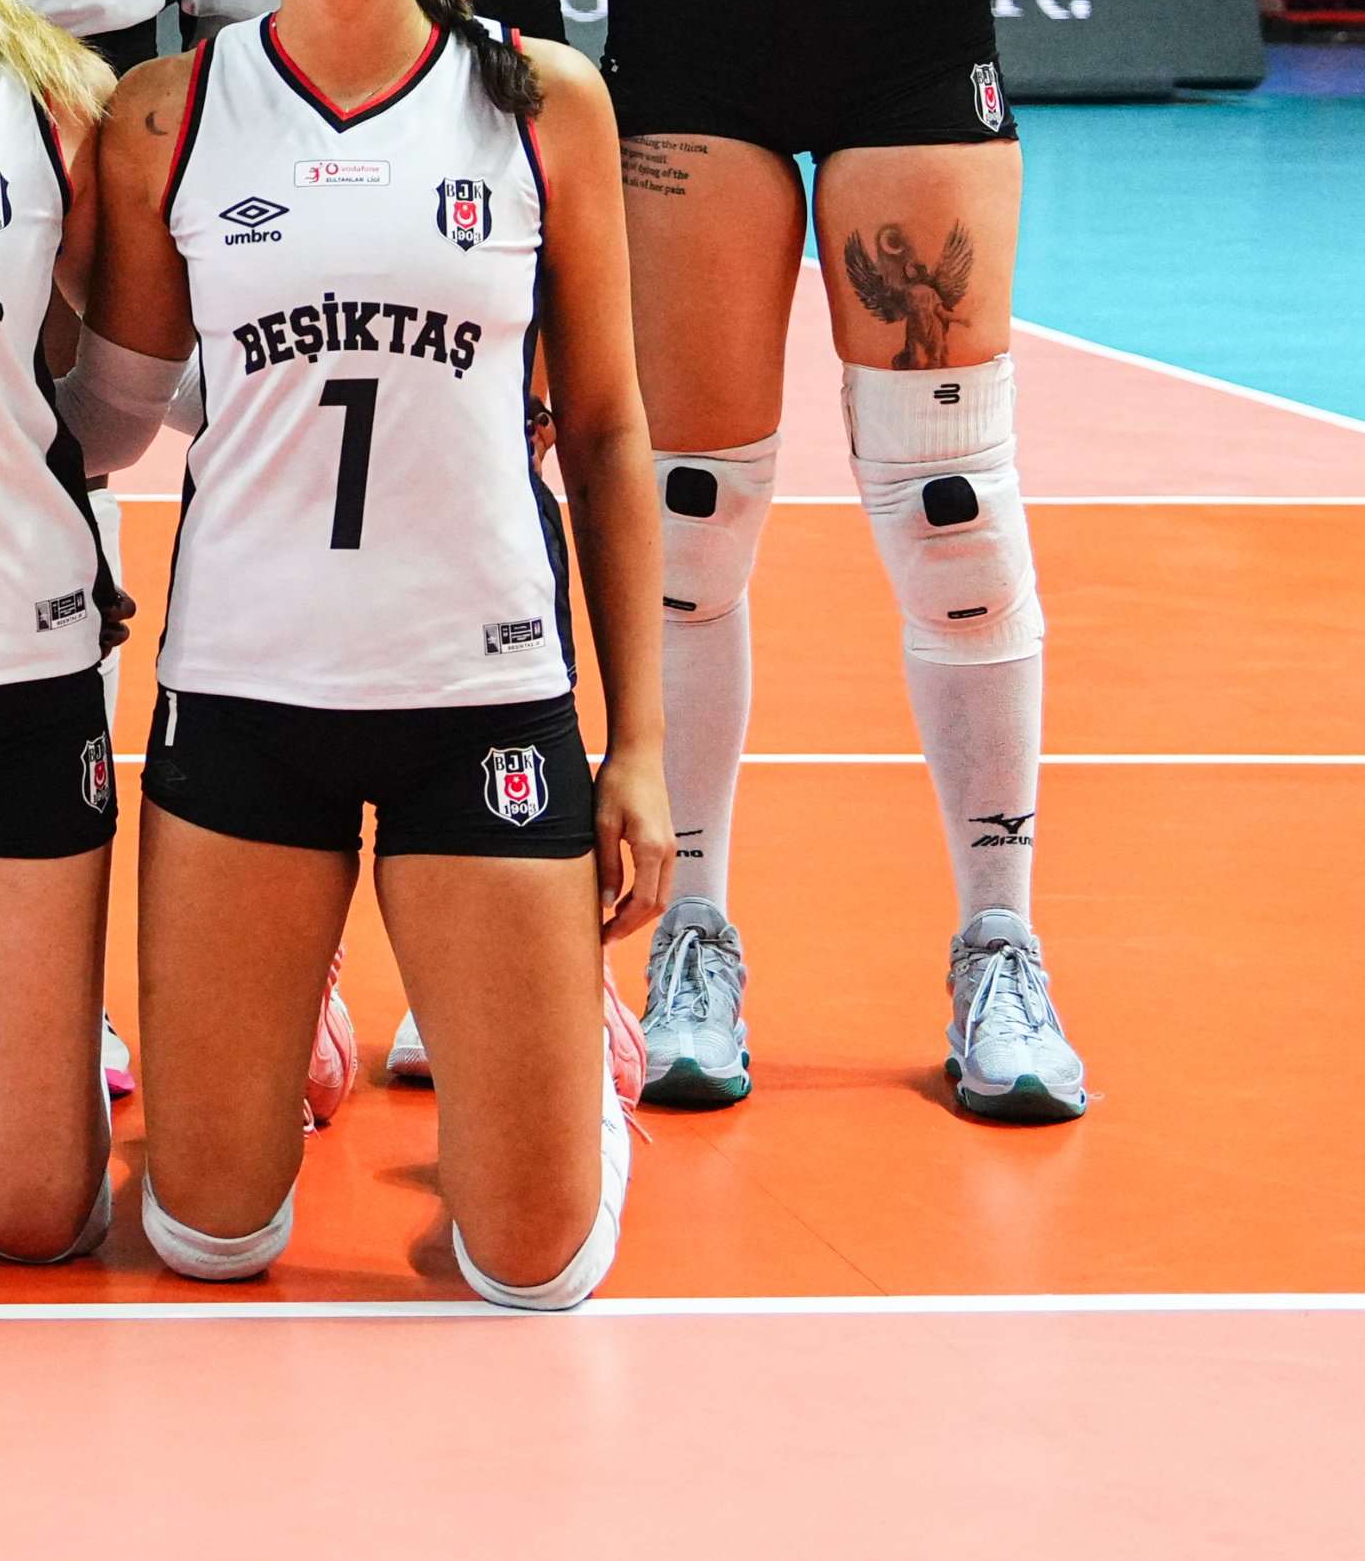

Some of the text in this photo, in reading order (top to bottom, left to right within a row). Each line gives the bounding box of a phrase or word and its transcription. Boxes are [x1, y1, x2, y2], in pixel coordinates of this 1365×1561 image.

[341, 165, 380, 173] vodafone
[446, 183, 483, 200] BJK
[225, 229, 282, 246] umbro
[451, 230, 482, 242] 1903
[233, 292, 482, 380] BEŞİKTAŞ
[495, 754, 533, 772] BJK
[503, 801, 537, 816] 1903
